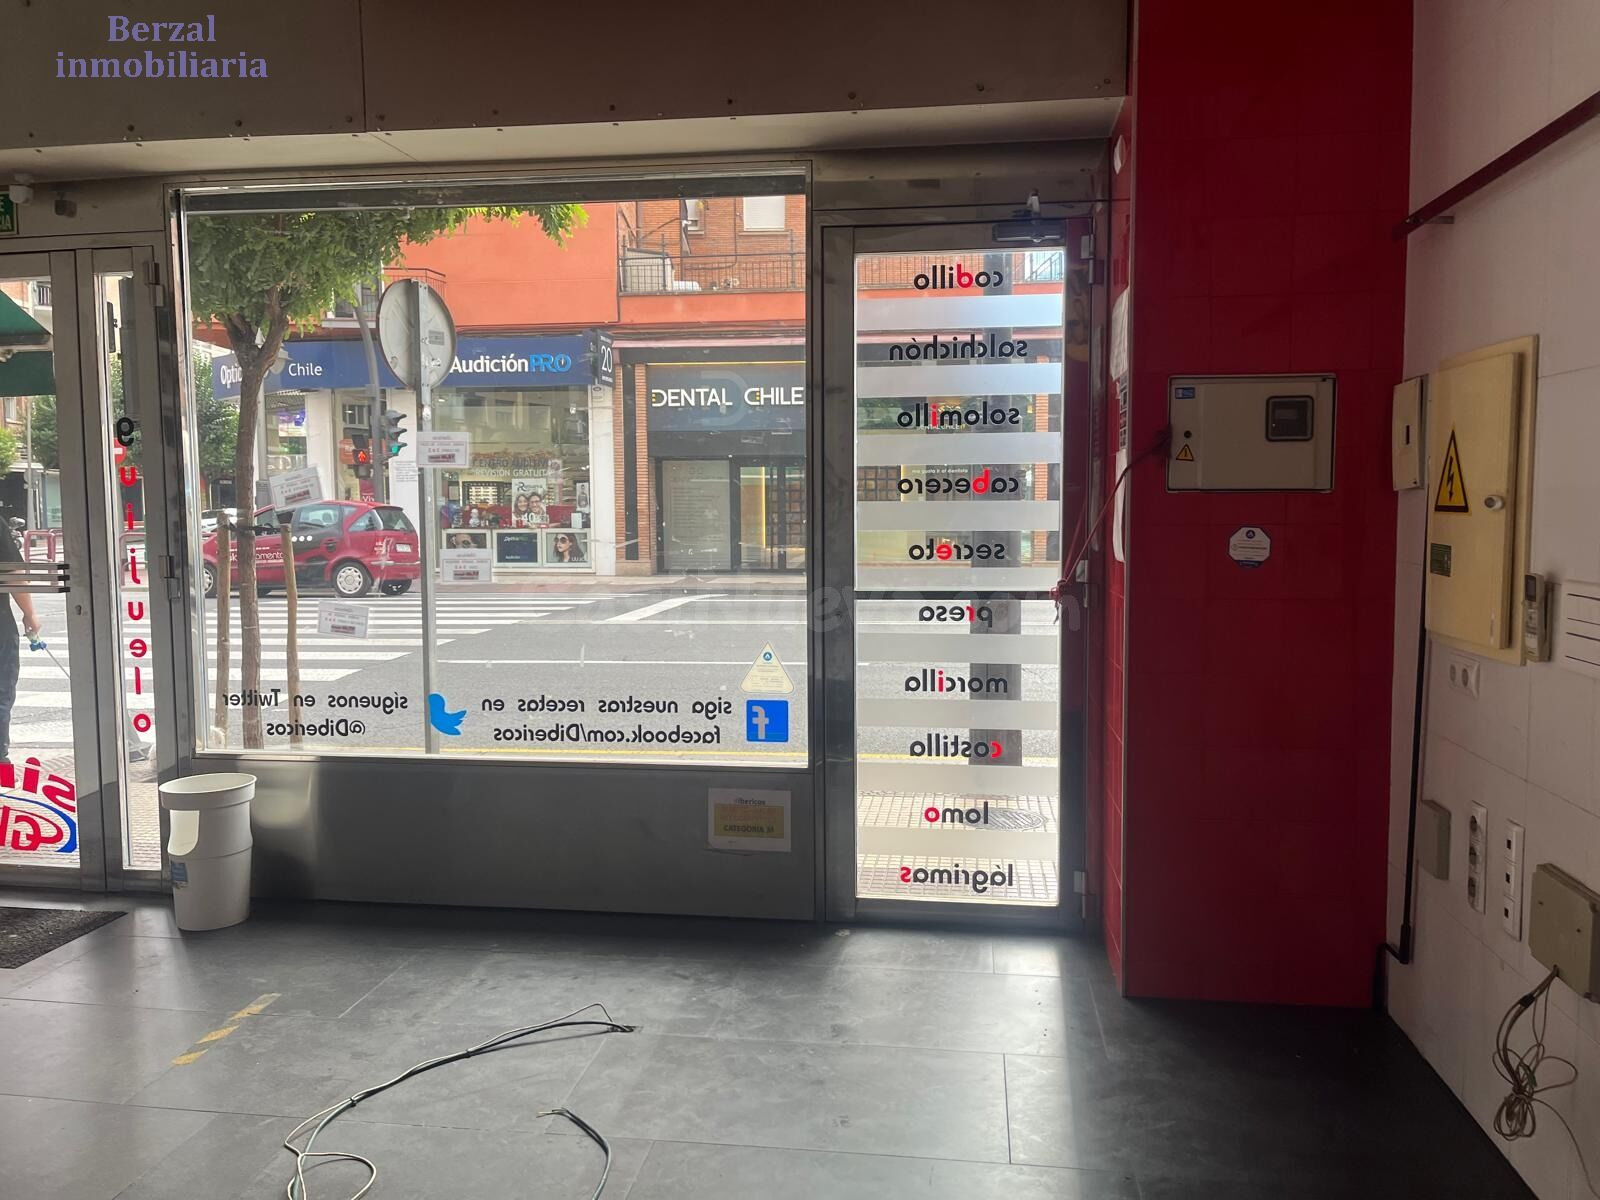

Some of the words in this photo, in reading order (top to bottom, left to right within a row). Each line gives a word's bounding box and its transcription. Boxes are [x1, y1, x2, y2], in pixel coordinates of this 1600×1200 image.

[601, 344, 613, 374] 20
[288, 363, 323, 377] Chile
[651, 388, 734, 407] DENTAL
[744, 387, 805, 406] CHILE
